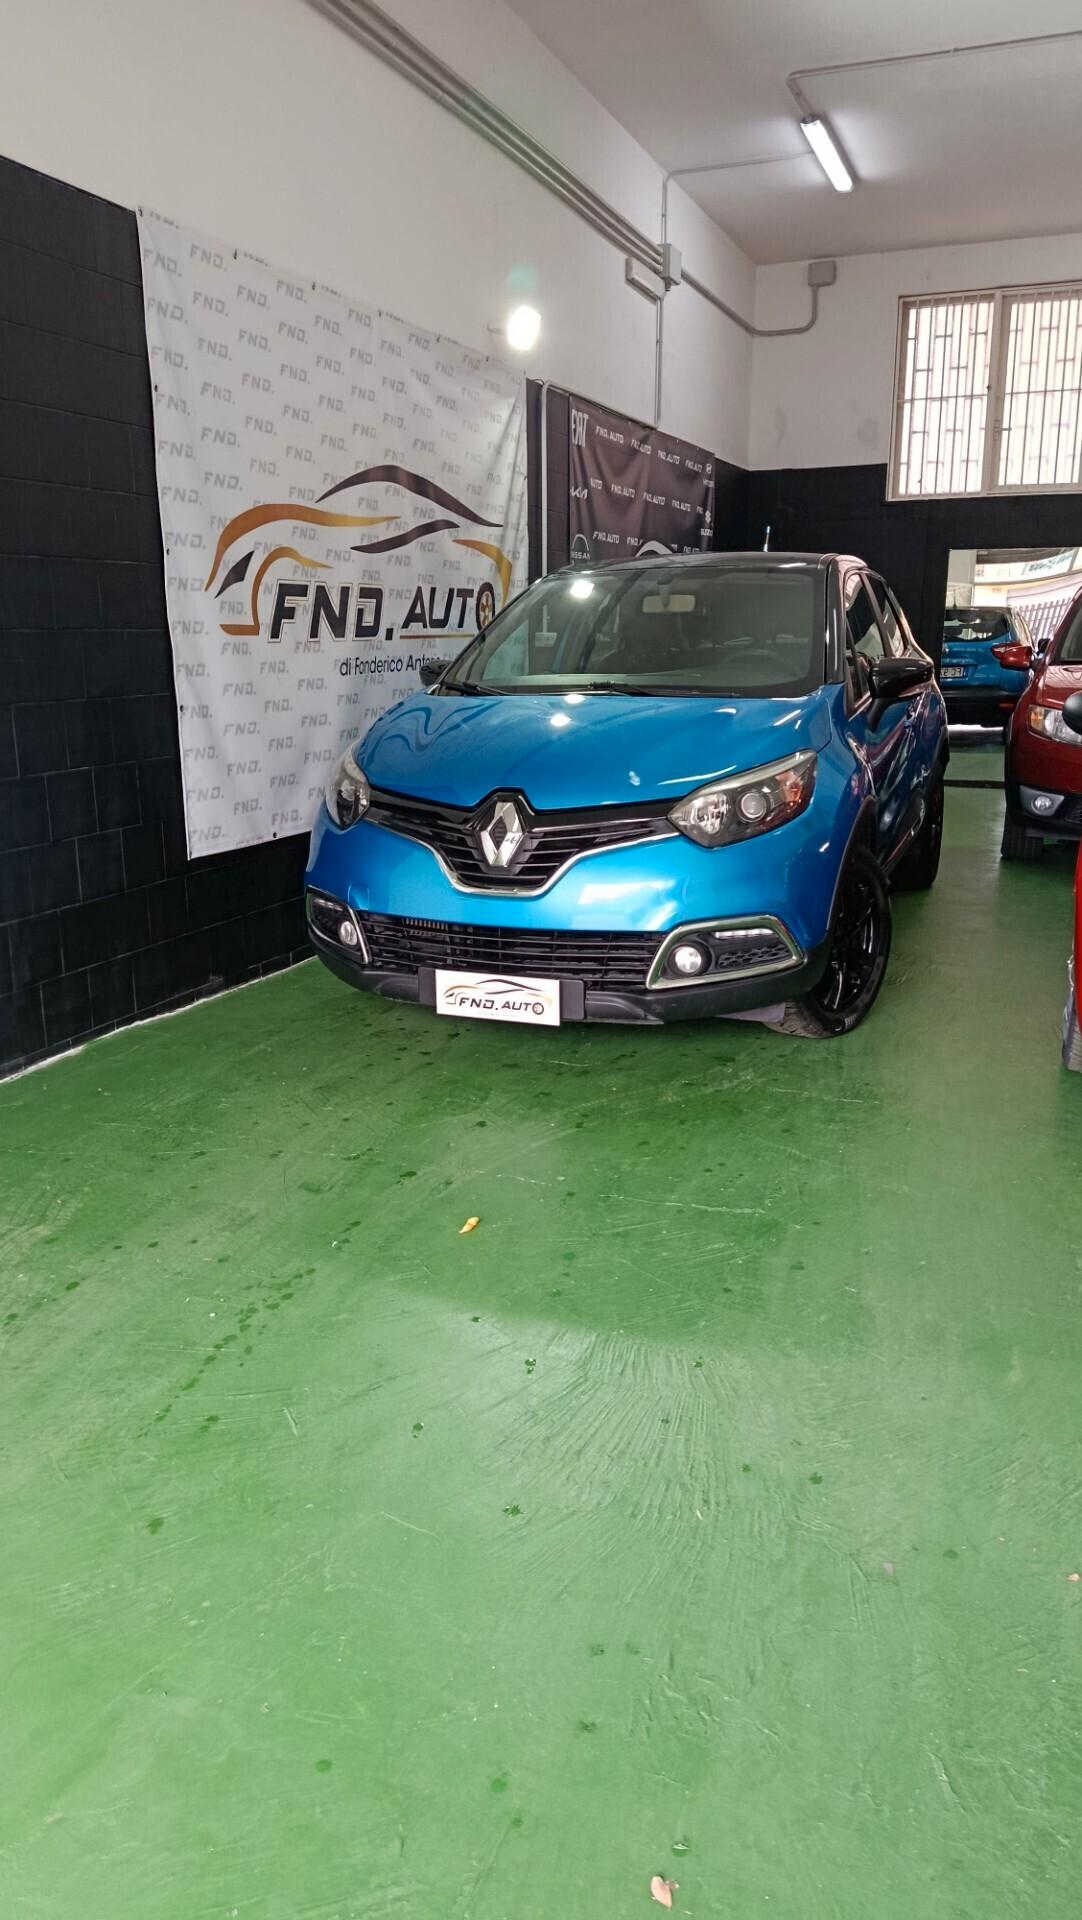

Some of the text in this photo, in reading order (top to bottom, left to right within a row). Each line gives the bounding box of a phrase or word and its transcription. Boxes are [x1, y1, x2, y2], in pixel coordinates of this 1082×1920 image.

[143, 248, 182, 277] FND.
[190, 244, 228, 272] FND.
[236, 285, 271, 311] FND.
[276, 280, 307, 303] FND.
[147, 297, 188, 324] FND.
[193, 291, 229, 317] FND.
[314, 315, 343, 336] FND.
[347, 308, 373, 329] FND.
[238, 329, 271, 352] FND.
[278, 321, 308, 345] FND.
[407, 333, 431, 352] FND.
[151, 345, 189, 371] FND.
[198, 338, 232, 361] FND.
[349, 347, 377, 367] FND.
[280, 364, 311, 385] FND.
[316, 355, 345, 376] FND.
[200, 382, 236, 405] FND.
[242, 373, 275, 395] FND.
[381, 375, 408, 395] FND.
[155, 393, 191, 417] FND.
[318, 394, 346, 414] FND.
[436, 394, 458, 412] FND.
[283, 404, 313, 424] FND.
[382, 412, 407, 431] FND.
[244, 415, 278, 436] FND.
[201, 427, 241, 449] FND.
[320, 434, 347, 452] FND.
[412, 438, 437, 455] FND.
[285, 445, 316, 465] FND.
[249, 458, 281, 478] FND.
[204, 471, 243, 492] FND.
[161, 486, 203, 506] FND.
[165, 532, 207, 550] FND.
[292, 525, 320, 541] FND.
[325, 547, 355, 563] FND.
[386, 554, 413, 568] FND.
[220, 600, 247, 615] FND.
[268, 578, 495, 642] FND. AUTO
[172, 622, 209, 635] FND.
[222, 642, 252, 656] FND.
[294, 641, 325, 654] FND.
[177, 663, 211, 678] FND.
[259, 661, 289, 674] FND.
[339, 657, 352, 676] di
[354, 656, 404, 675] Fonderico
[222, 682, 257, 696] FND.
[297, 679, 328, 691] FND.
[363, 674, 387, 685] FND.
[264, 699, 293, 713] FND.
[337, 693, 360, 706] FND.
[181, 705, 213, 719] FND.
[301, 714, 332, 728] FND.
[223, 721, 260, 736] FND.
[340, 727, 360, 741] FND.
[184, 746, 218, 761] FND.
[268, 736, 297, 752] FND.
[303, 749, 336, 764] FND.
[226, 760, 262, 776] FND.
[269, 773, 299, 789] FND.
[187, 785, 225, 801] FND.
[233, 798, 263, 816] FND.
[271, 809, 303, 826] FND.
[189, 825, 225, 841] FND.
[458, 997, 498, 1011] FND.
[501, 1001, 544, 1016] AUTO
